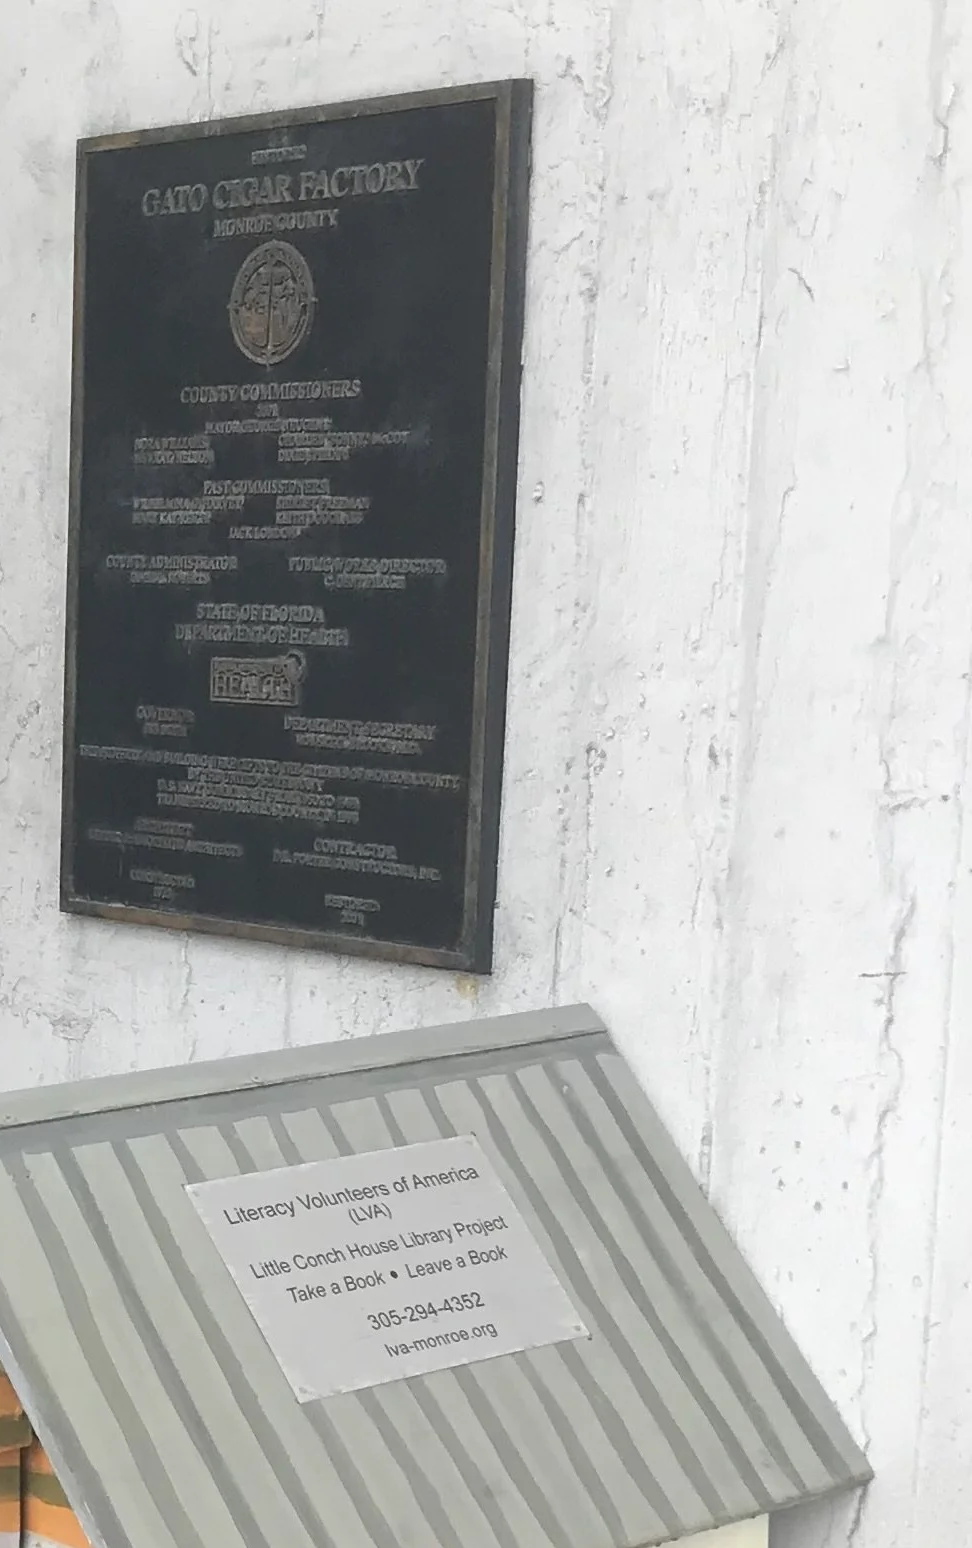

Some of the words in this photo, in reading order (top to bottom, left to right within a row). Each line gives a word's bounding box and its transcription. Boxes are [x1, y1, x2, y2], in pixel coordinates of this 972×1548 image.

[141, 183, 208, 216] GATO
[212, 173, 294, 210] CIGAR
[297, 158, 425, 201] FACTORY
[275, 208, 339, 232] COUNTY
[223, 1198, 296, 1225] Literacy
[295, 1178, 390, 1213] Volunteers
[392, 1175, 411, 1194] of
[412, 1165, 480, 1191] America
[347, 1202, 393, 1226] (LVA)
[249, 1257, 291, 1280] Little
[292, 1247, 347, 1272] Conch
[347, 1237, 399, 1260] House
[399, 1223, 454, 1249] Library
[453, 1215, 509, 1240] Project
[286, 1281, 327, 1305] Take
[330, 1281, 343, 1296] a
[342, 1270, 387, 1293] Book
[404, 1257, 453, 1280] Leave
[454, 1255, 467, 1270] a
[468, 1245, 509, 1265] Book
[366, 1291, 486, 1332] 305-294-4352
[383, 1321, 499, 1359] lva-monroe.org
